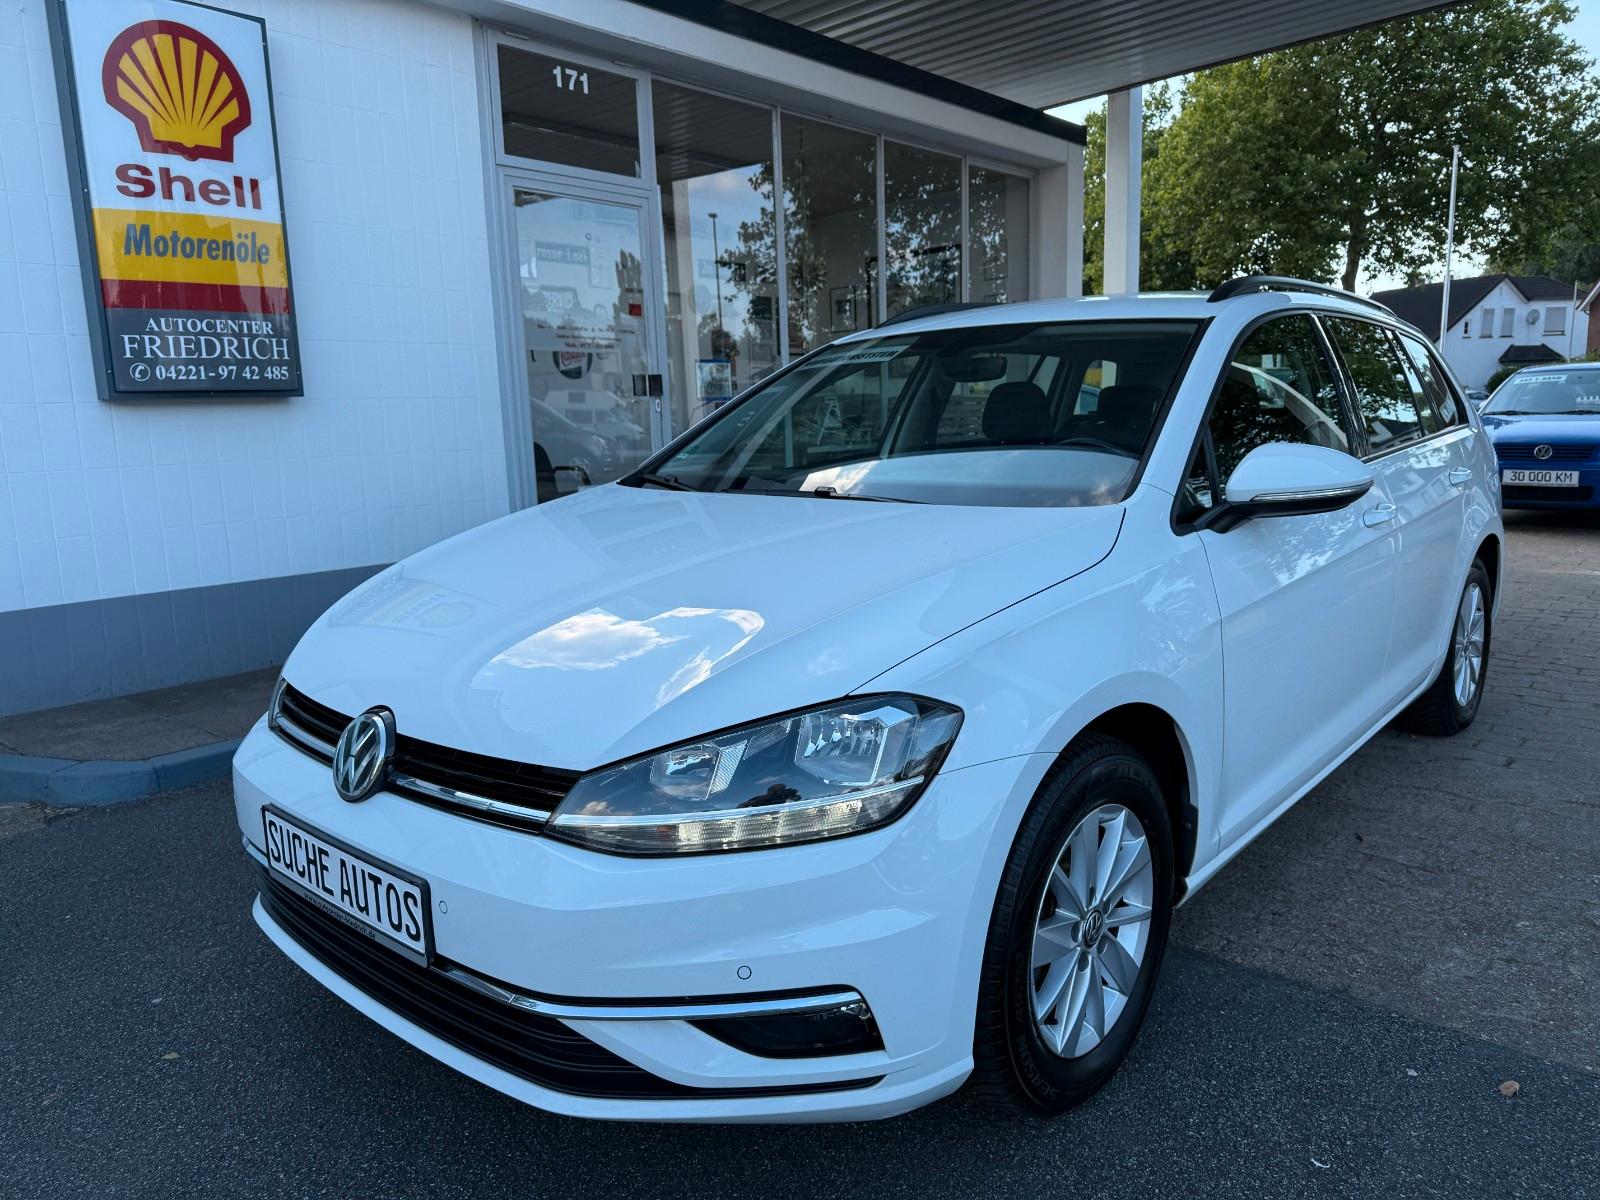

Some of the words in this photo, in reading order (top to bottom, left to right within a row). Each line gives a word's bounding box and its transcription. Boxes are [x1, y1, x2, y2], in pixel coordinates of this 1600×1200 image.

[552, 65, 589, 95] 171
[115, 163, 262, 210] Shell
[124, 223, 270, 265] Motorenöle
[146, 317, 274, 335] AUTOCENTER
[120, 334, 290, 361] FRIEDRICH
[242, 366, 260, 380] 42
[264, 366, 289, 380] 485
[1510, 471, 1526, 481] 30
[1528, 471, 1552, 483] 000
[1555, 472, 1573, 483] KM
[267, 819, 334, 896] SUCHE
[340, 857, 422, 942] AUTOS
